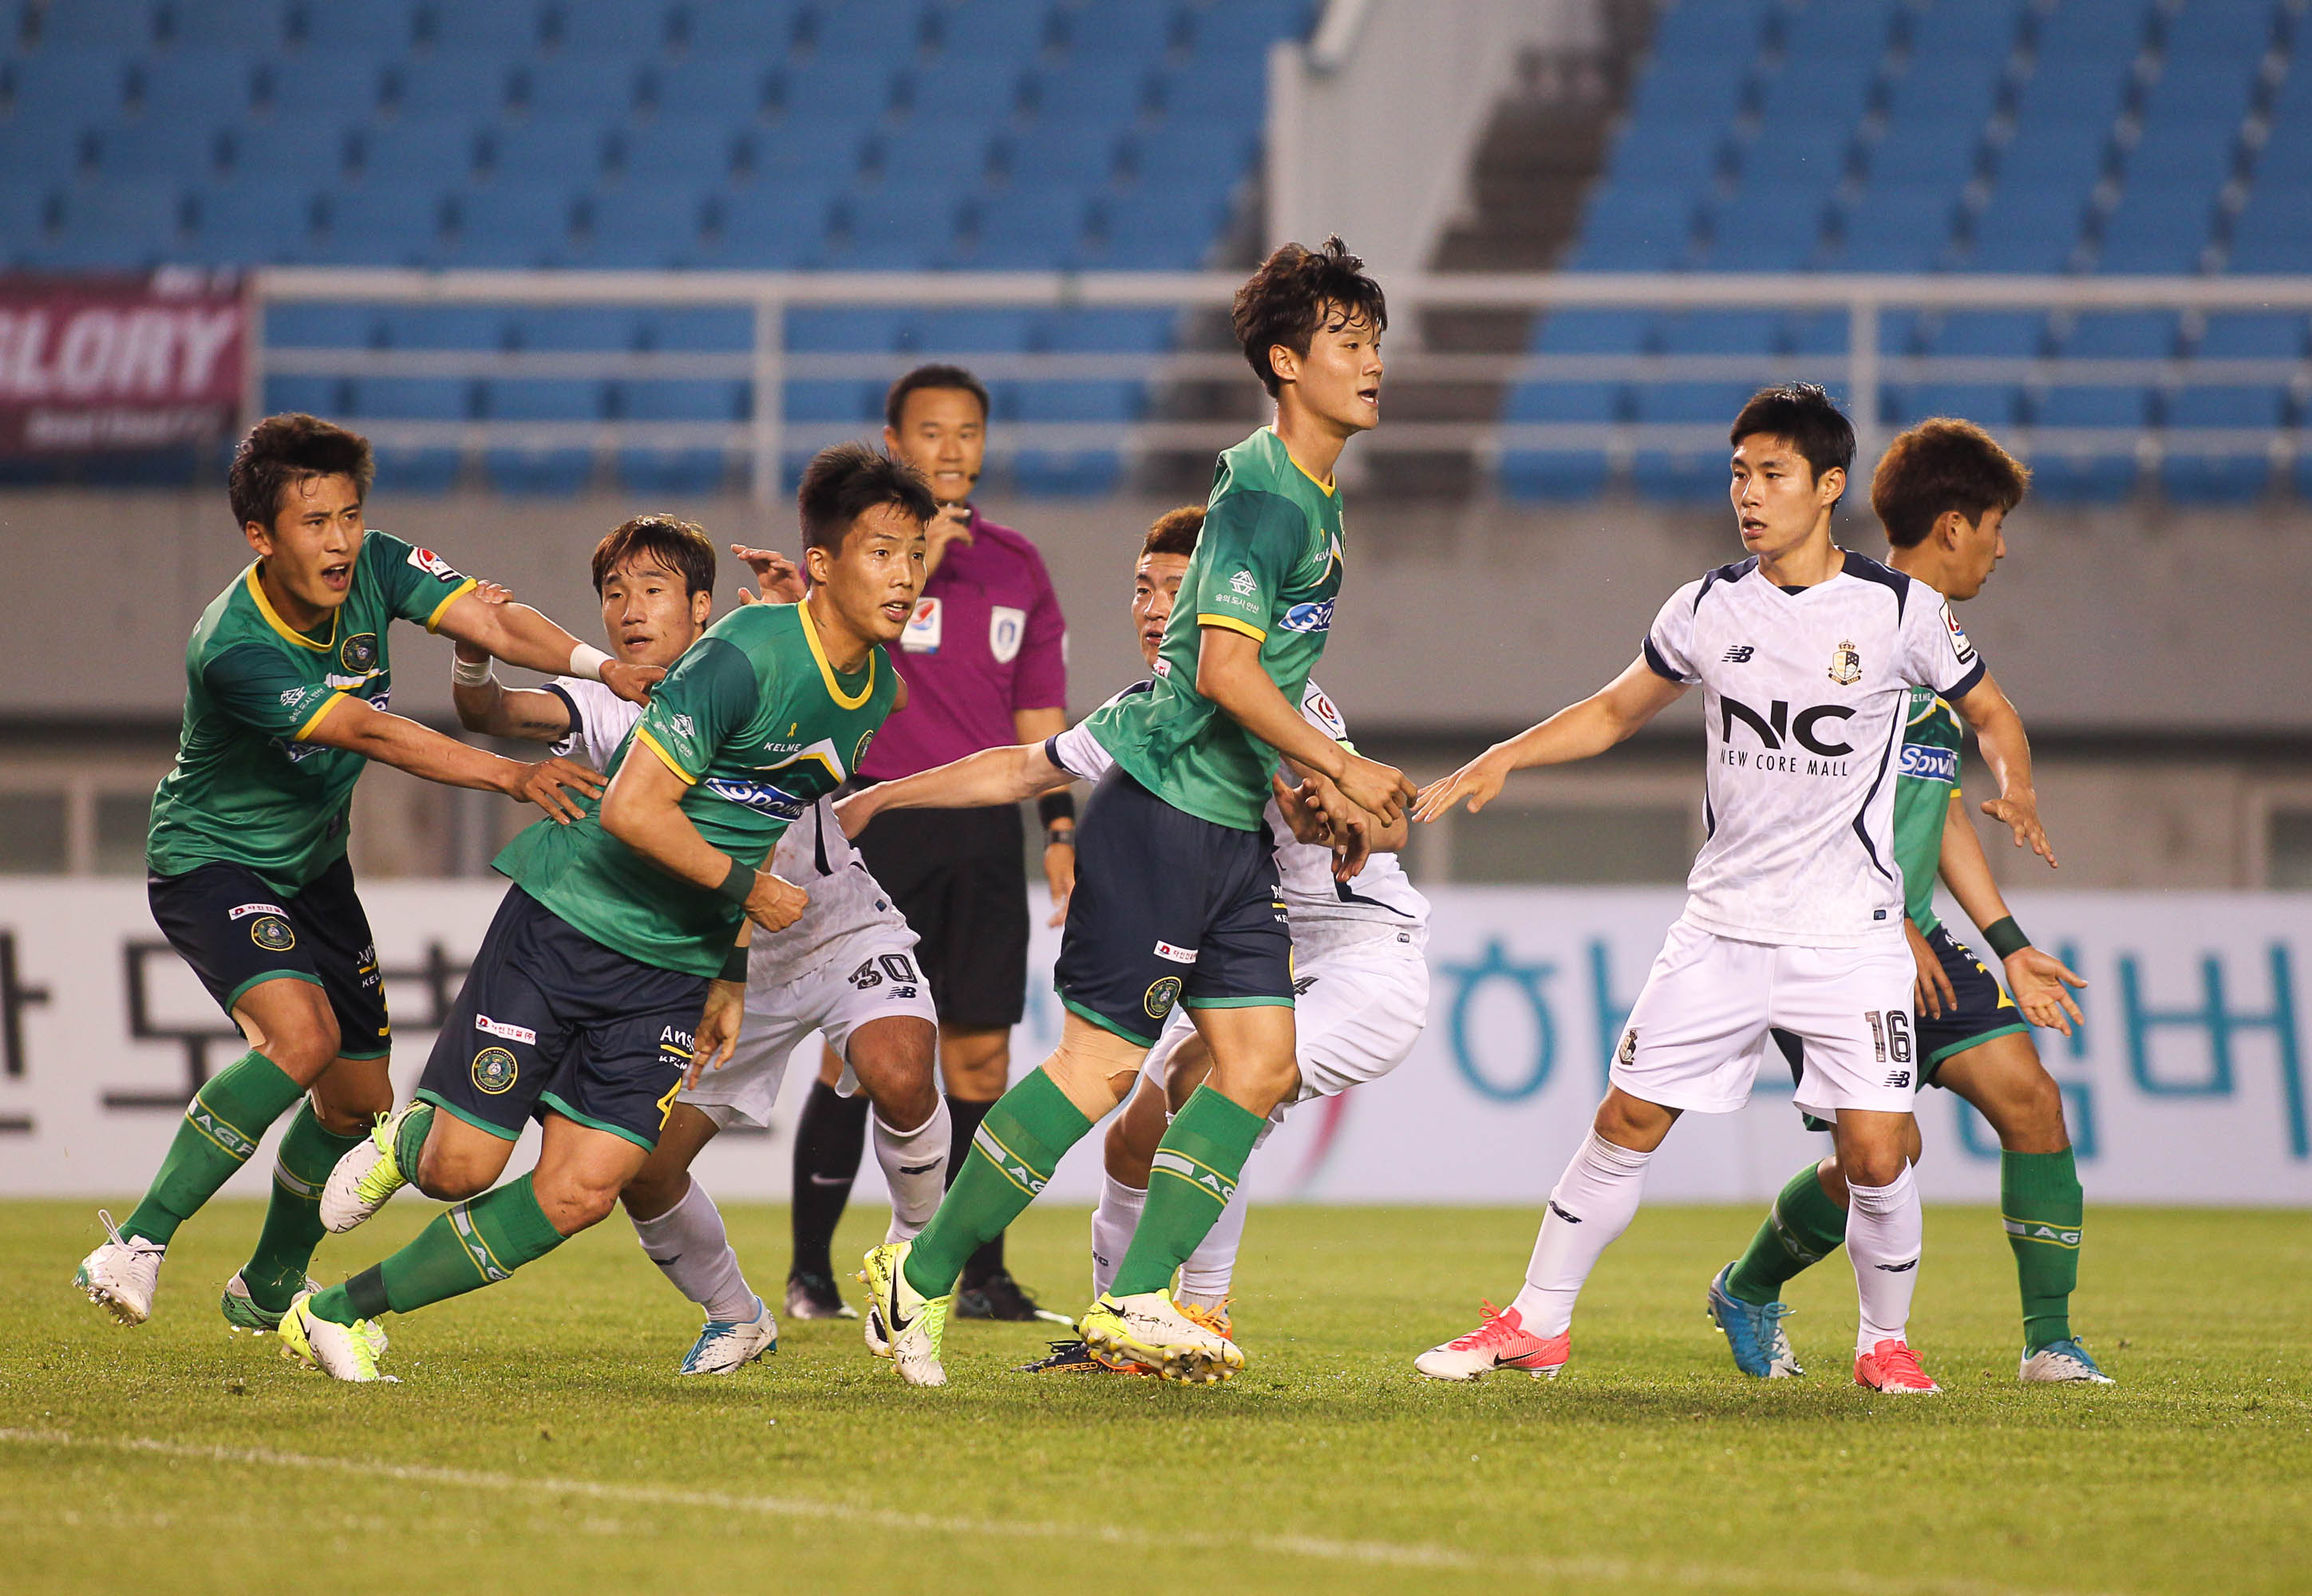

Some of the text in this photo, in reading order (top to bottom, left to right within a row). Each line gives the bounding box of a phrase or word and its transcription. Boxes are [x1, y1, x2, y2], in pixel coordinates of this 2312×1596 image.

[0, 306, 241, 394] LORY
[1246, 602, 1259, 614] 안산
[1912, 692, 1931, 702] ELME
[1720, 694, 1857, 757] NC
[763, 742, 802, 752] KELME
[1720, 748, 1848, 776] NEW CORE MALL
[848, 954, 918, 990] 30
[1864, 1010, 1911, 1063] 16
[2033, 1226, 2083, 1244] AG
